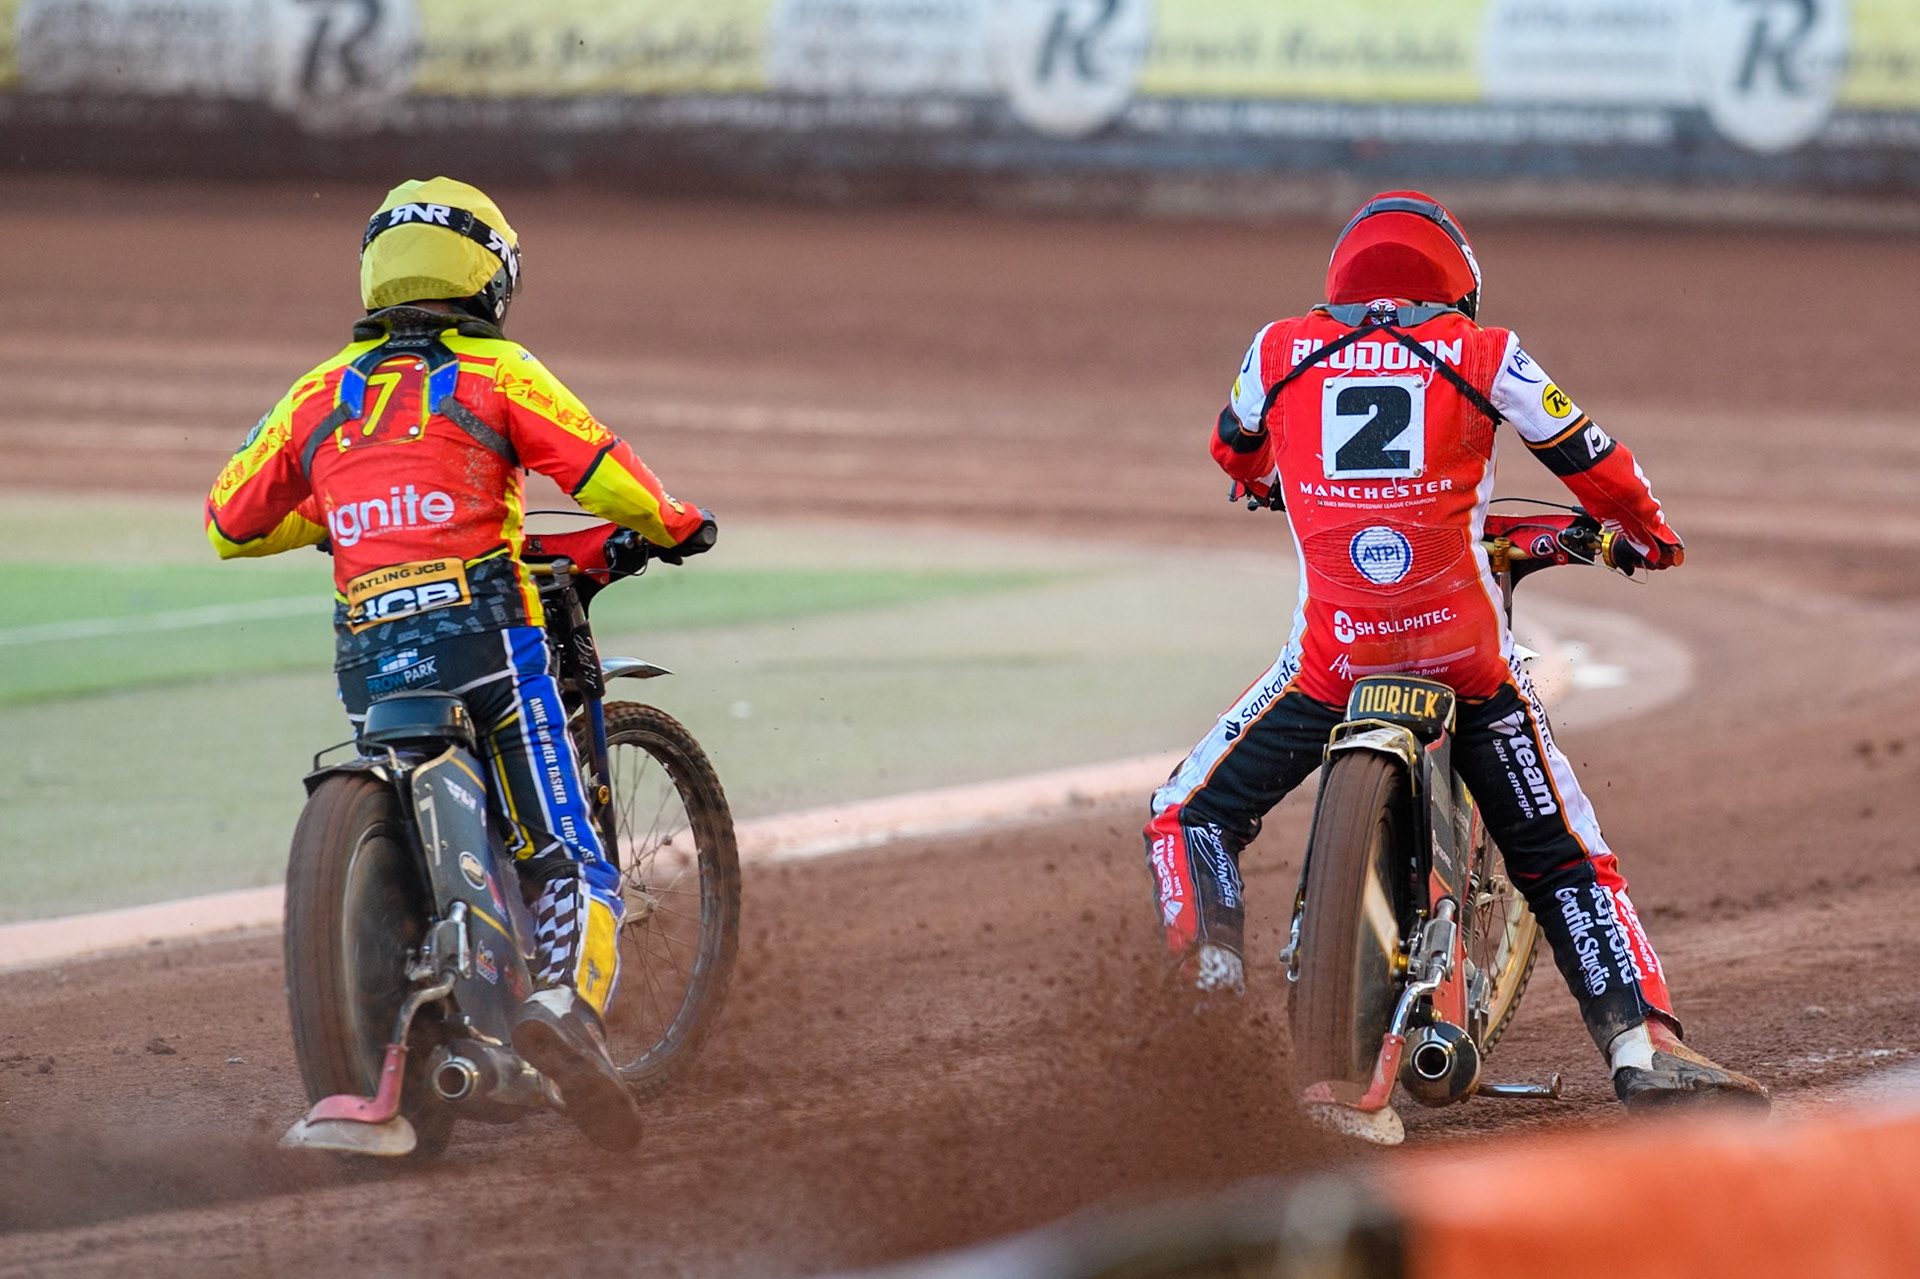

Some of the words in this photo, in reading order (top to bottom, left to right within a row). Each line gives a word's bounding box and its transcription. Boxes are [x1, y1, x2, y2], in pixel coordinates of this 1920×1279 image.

[366, 371, 402, 437] 7
[1336, 386, 1412, 472] 2
[1299, 478, 1453, 499] MANCHESTER
[1404, 497, 1437, 508] CHAMPIONS
[327, 484, 455, 547] ignite
[414, 562, 447, 576] JCB
[1362, 545, 1400, 562] ATPI
[353, 582, 460, 623] JCB
[1355, 621, 1375, 635] SH
[1421, 665, 1450, 677] Broker
[529, 697, 548, 726] ANNE
[547, 765, 568, 805] TASKER
[1492, 738, 1509, 763] bau
[1508, 770, 1534, 820] energie
[1509, 733, 1557, 816] team
